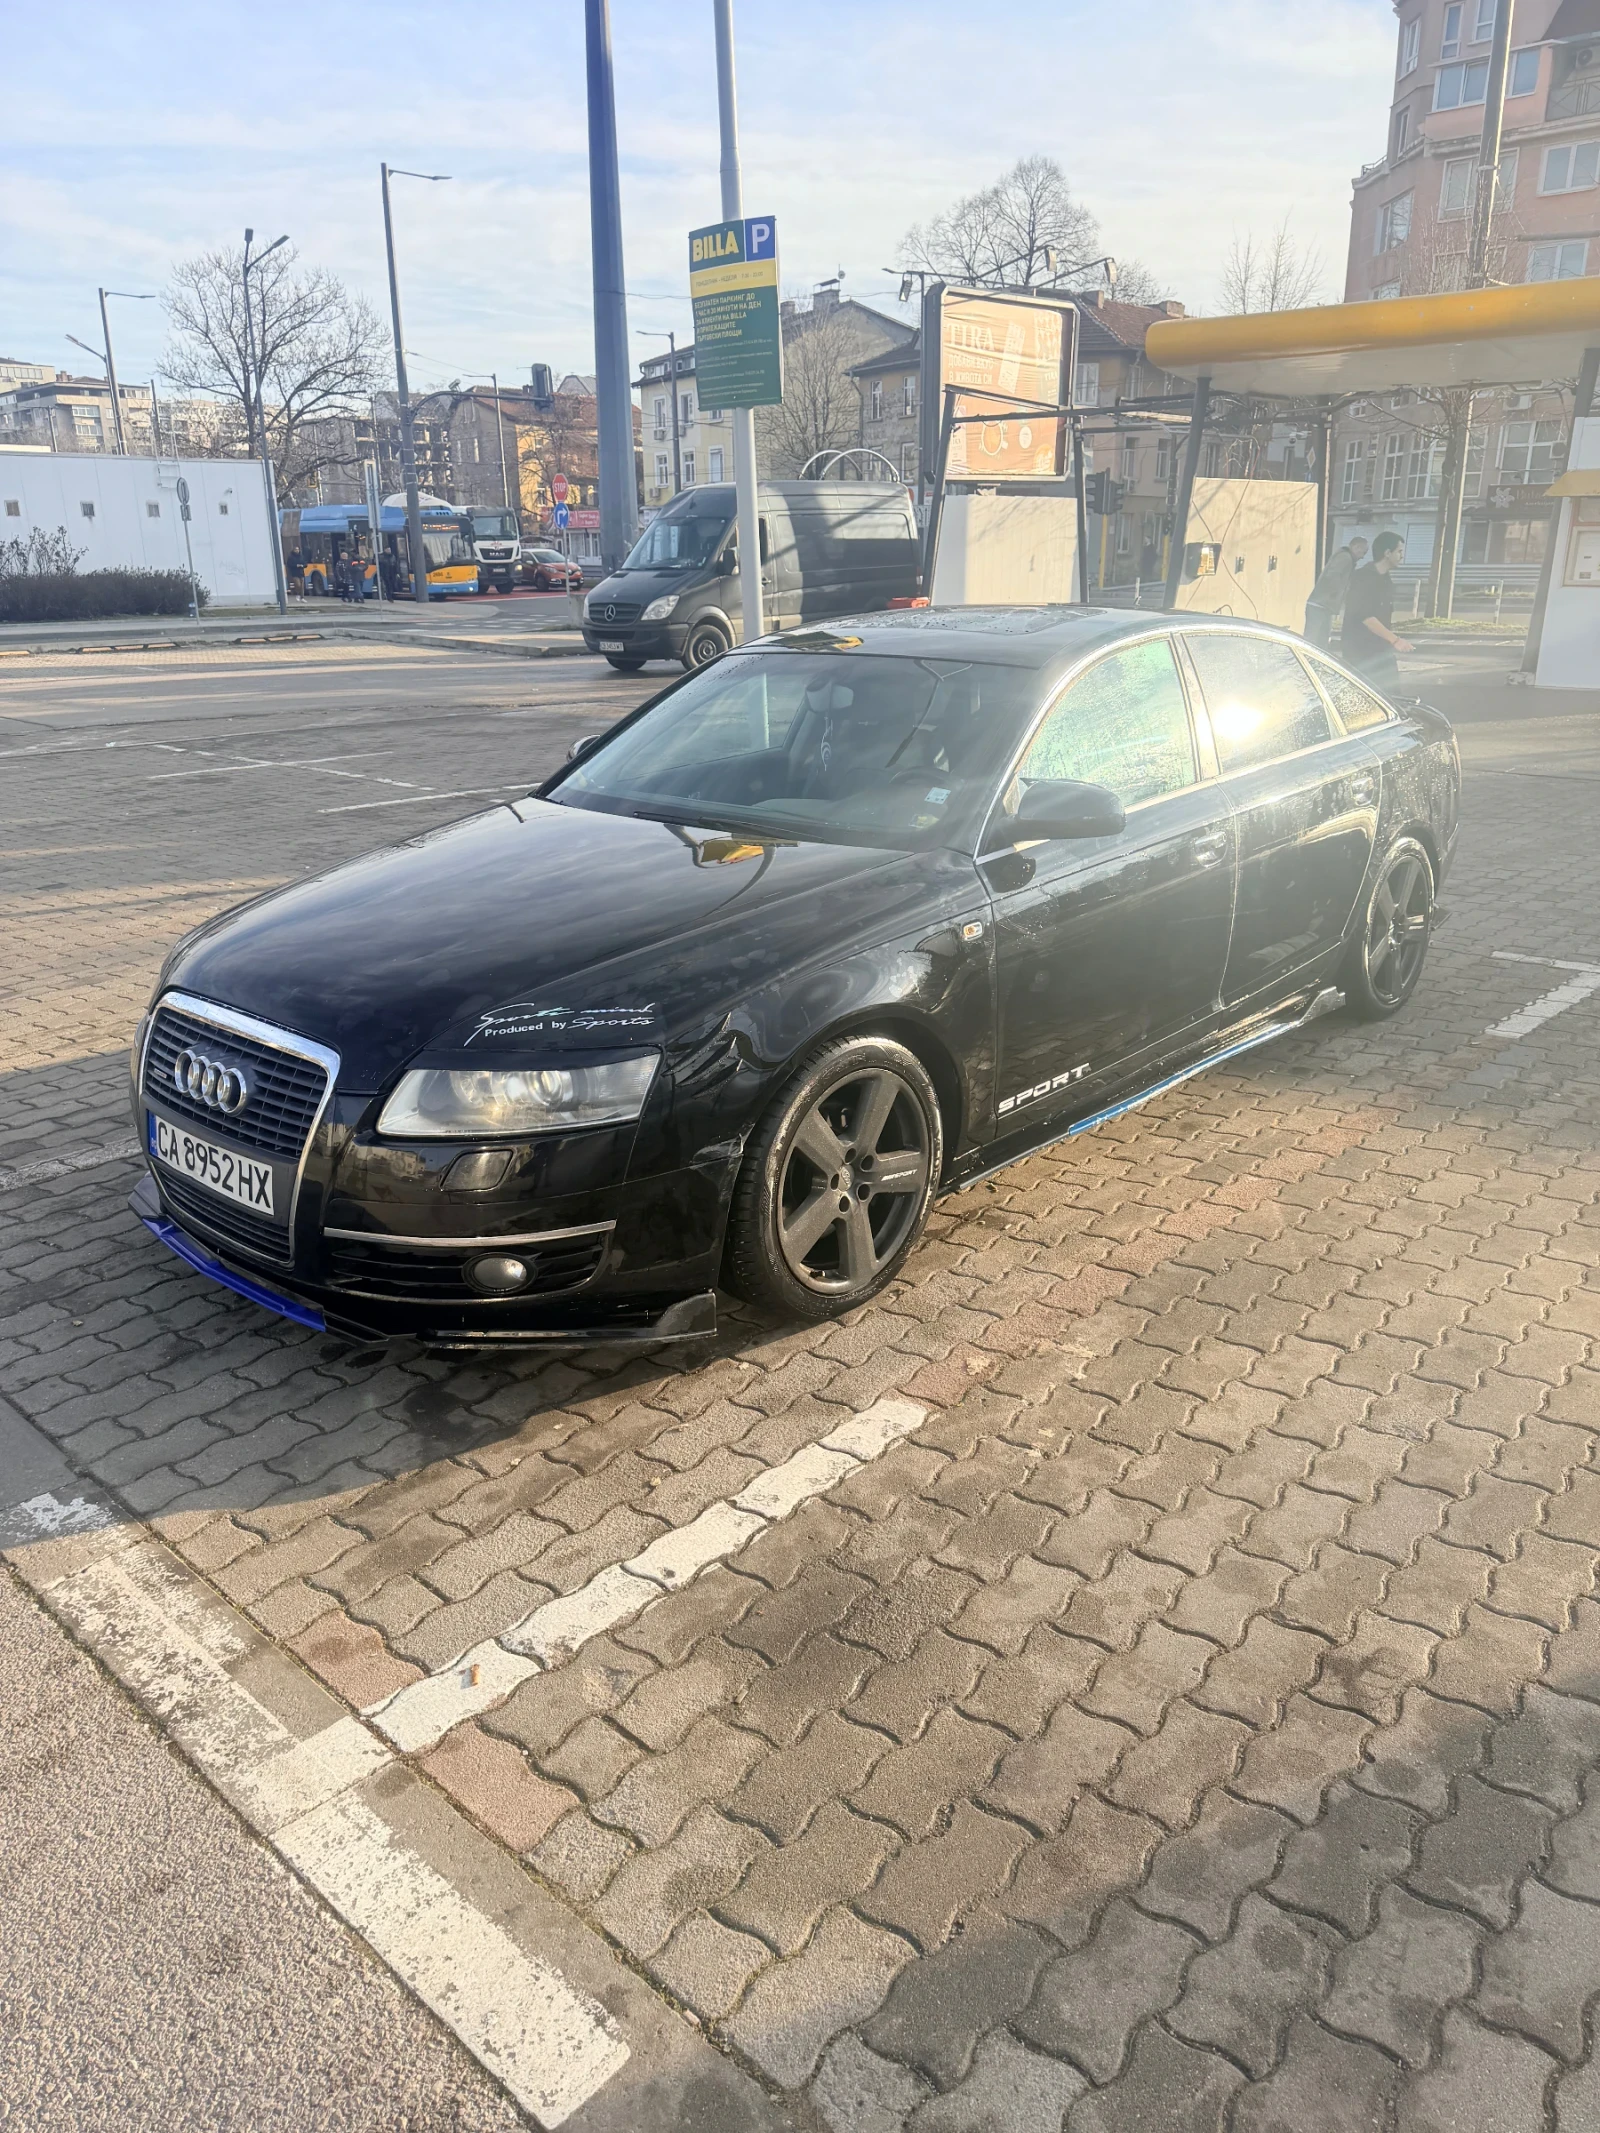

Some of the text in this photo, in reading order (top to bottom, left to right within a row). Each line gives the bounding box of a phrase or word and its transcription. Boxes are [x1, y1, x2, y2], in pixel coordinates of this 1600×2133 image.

[692, 231, 739, 262] BILLA
[751, 224, 770, 253] P
[694, 292, 755, 309] БЕЗПЛАТЕН ПАРКИНГ ДО
[717, 302, 738, 313] МИНУТИ
[748, 300, 761, 310] ДЕН
[730, 311, 747, 320] BILLA
[722, 329, 742, 338] ПЛОЩИ
[948, 371, 993, 384] В ЖИВОТА СИ
[554, 482, 566, 493] STOP
[484, 1016, 655, 1037] Produced by Sports
[998, 1062, 1090, 1114] SPORT
[183, 1136, 235, 1193] 8952
